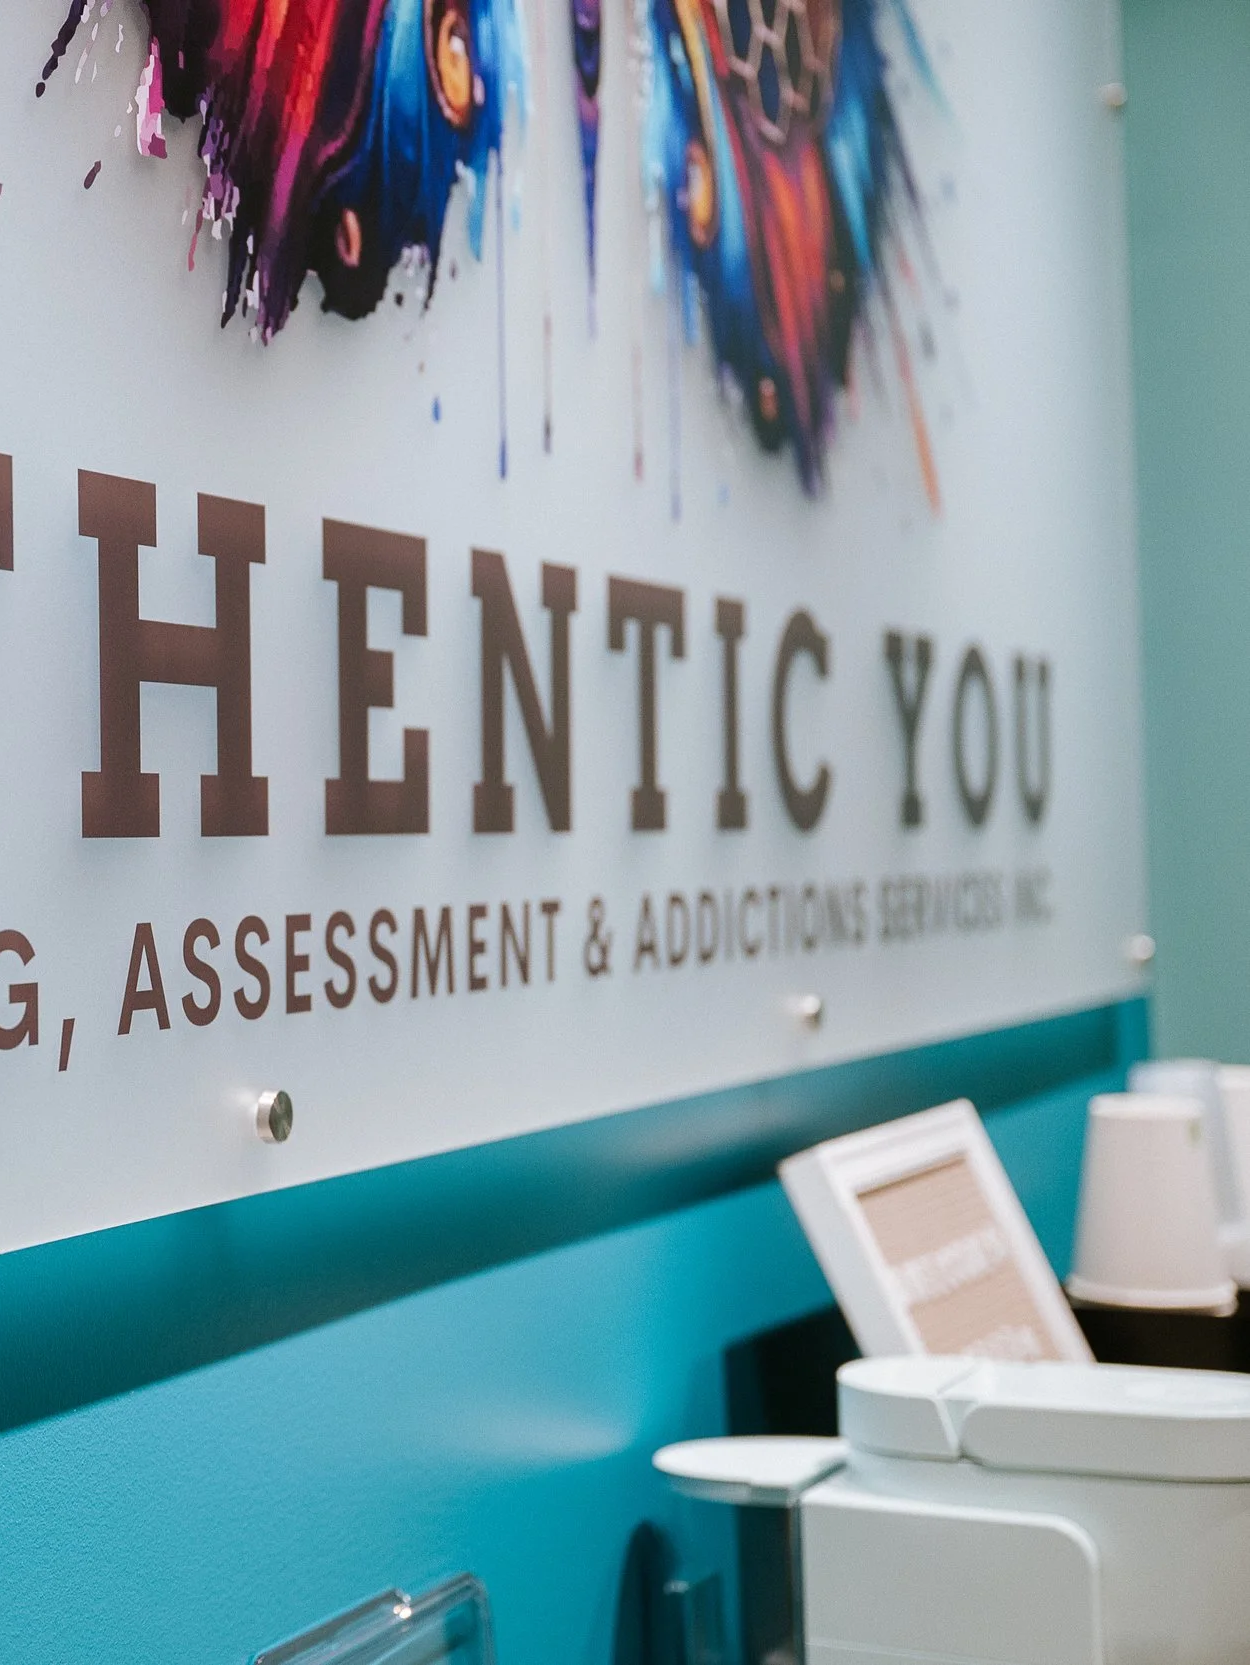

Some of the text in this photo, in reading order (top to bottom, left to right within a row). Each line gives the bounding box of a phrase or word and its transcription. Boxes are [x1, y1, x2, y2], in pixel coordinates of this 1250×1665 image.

[881, 628, 1054, 832] YOU
[117, 899, 561, 1037] ASSESSMENT
[583, 894, 612, 979] &
[633, 878, 870, 973] ADDICTIONS
